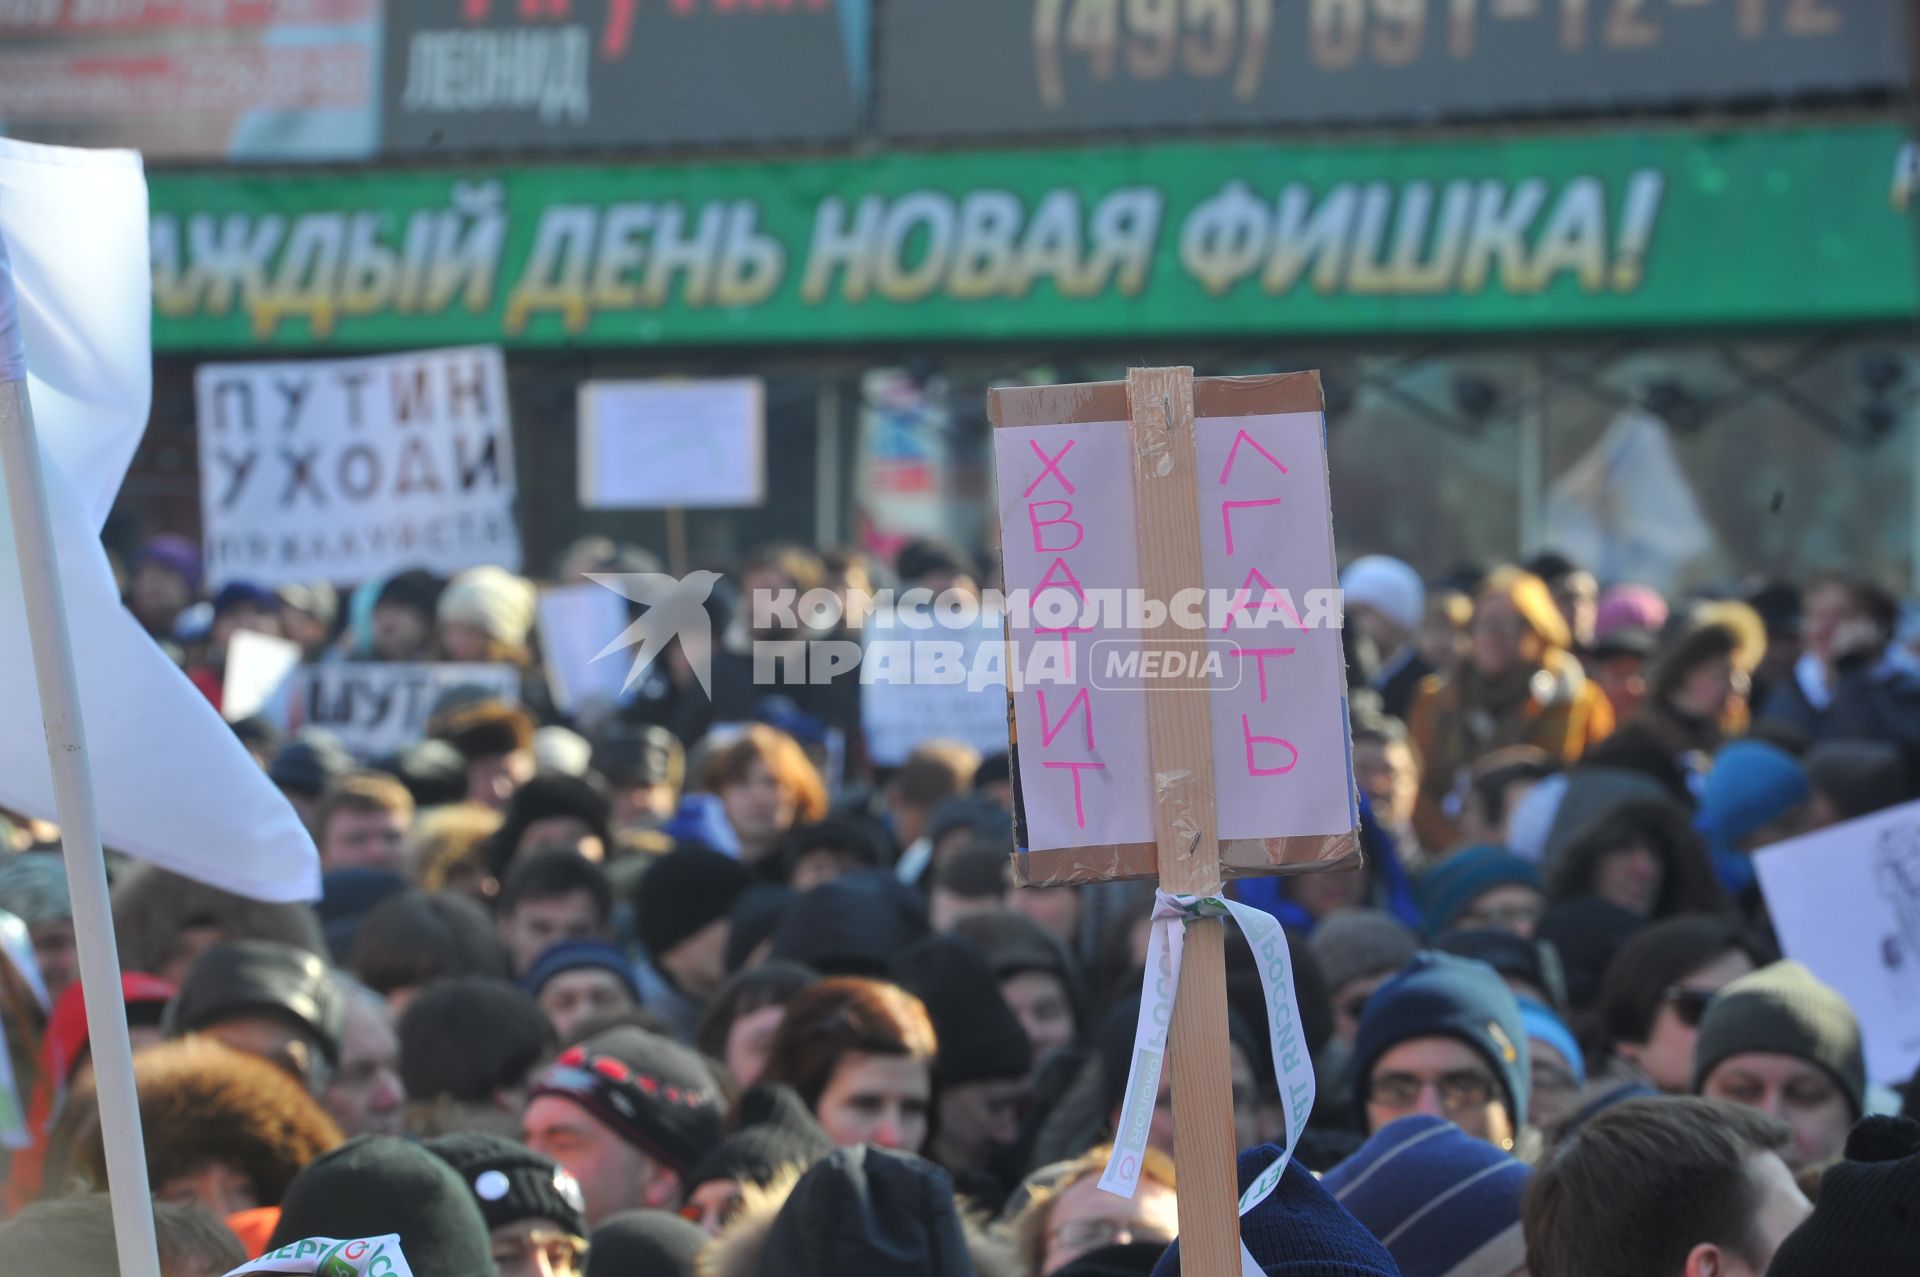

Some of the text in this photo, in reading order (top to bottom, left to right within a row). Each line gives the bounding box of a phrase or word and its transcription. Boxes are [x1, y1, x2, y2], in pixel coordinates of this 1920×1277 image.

[403, 25, 591, 124] ЛЕОНИД
[150, 168, 1664, 339] АЖДЫЙ ДЕНЬ НОВАЯ ФИШКА!
[210, 360, 490, 432] ПУТИН
[215, 434, 504, 508] УХОДИ
[1022, 439, 1106, 830] ХВАТИТ
[1218, 428, 1310, 778] ЛГАТЬ
